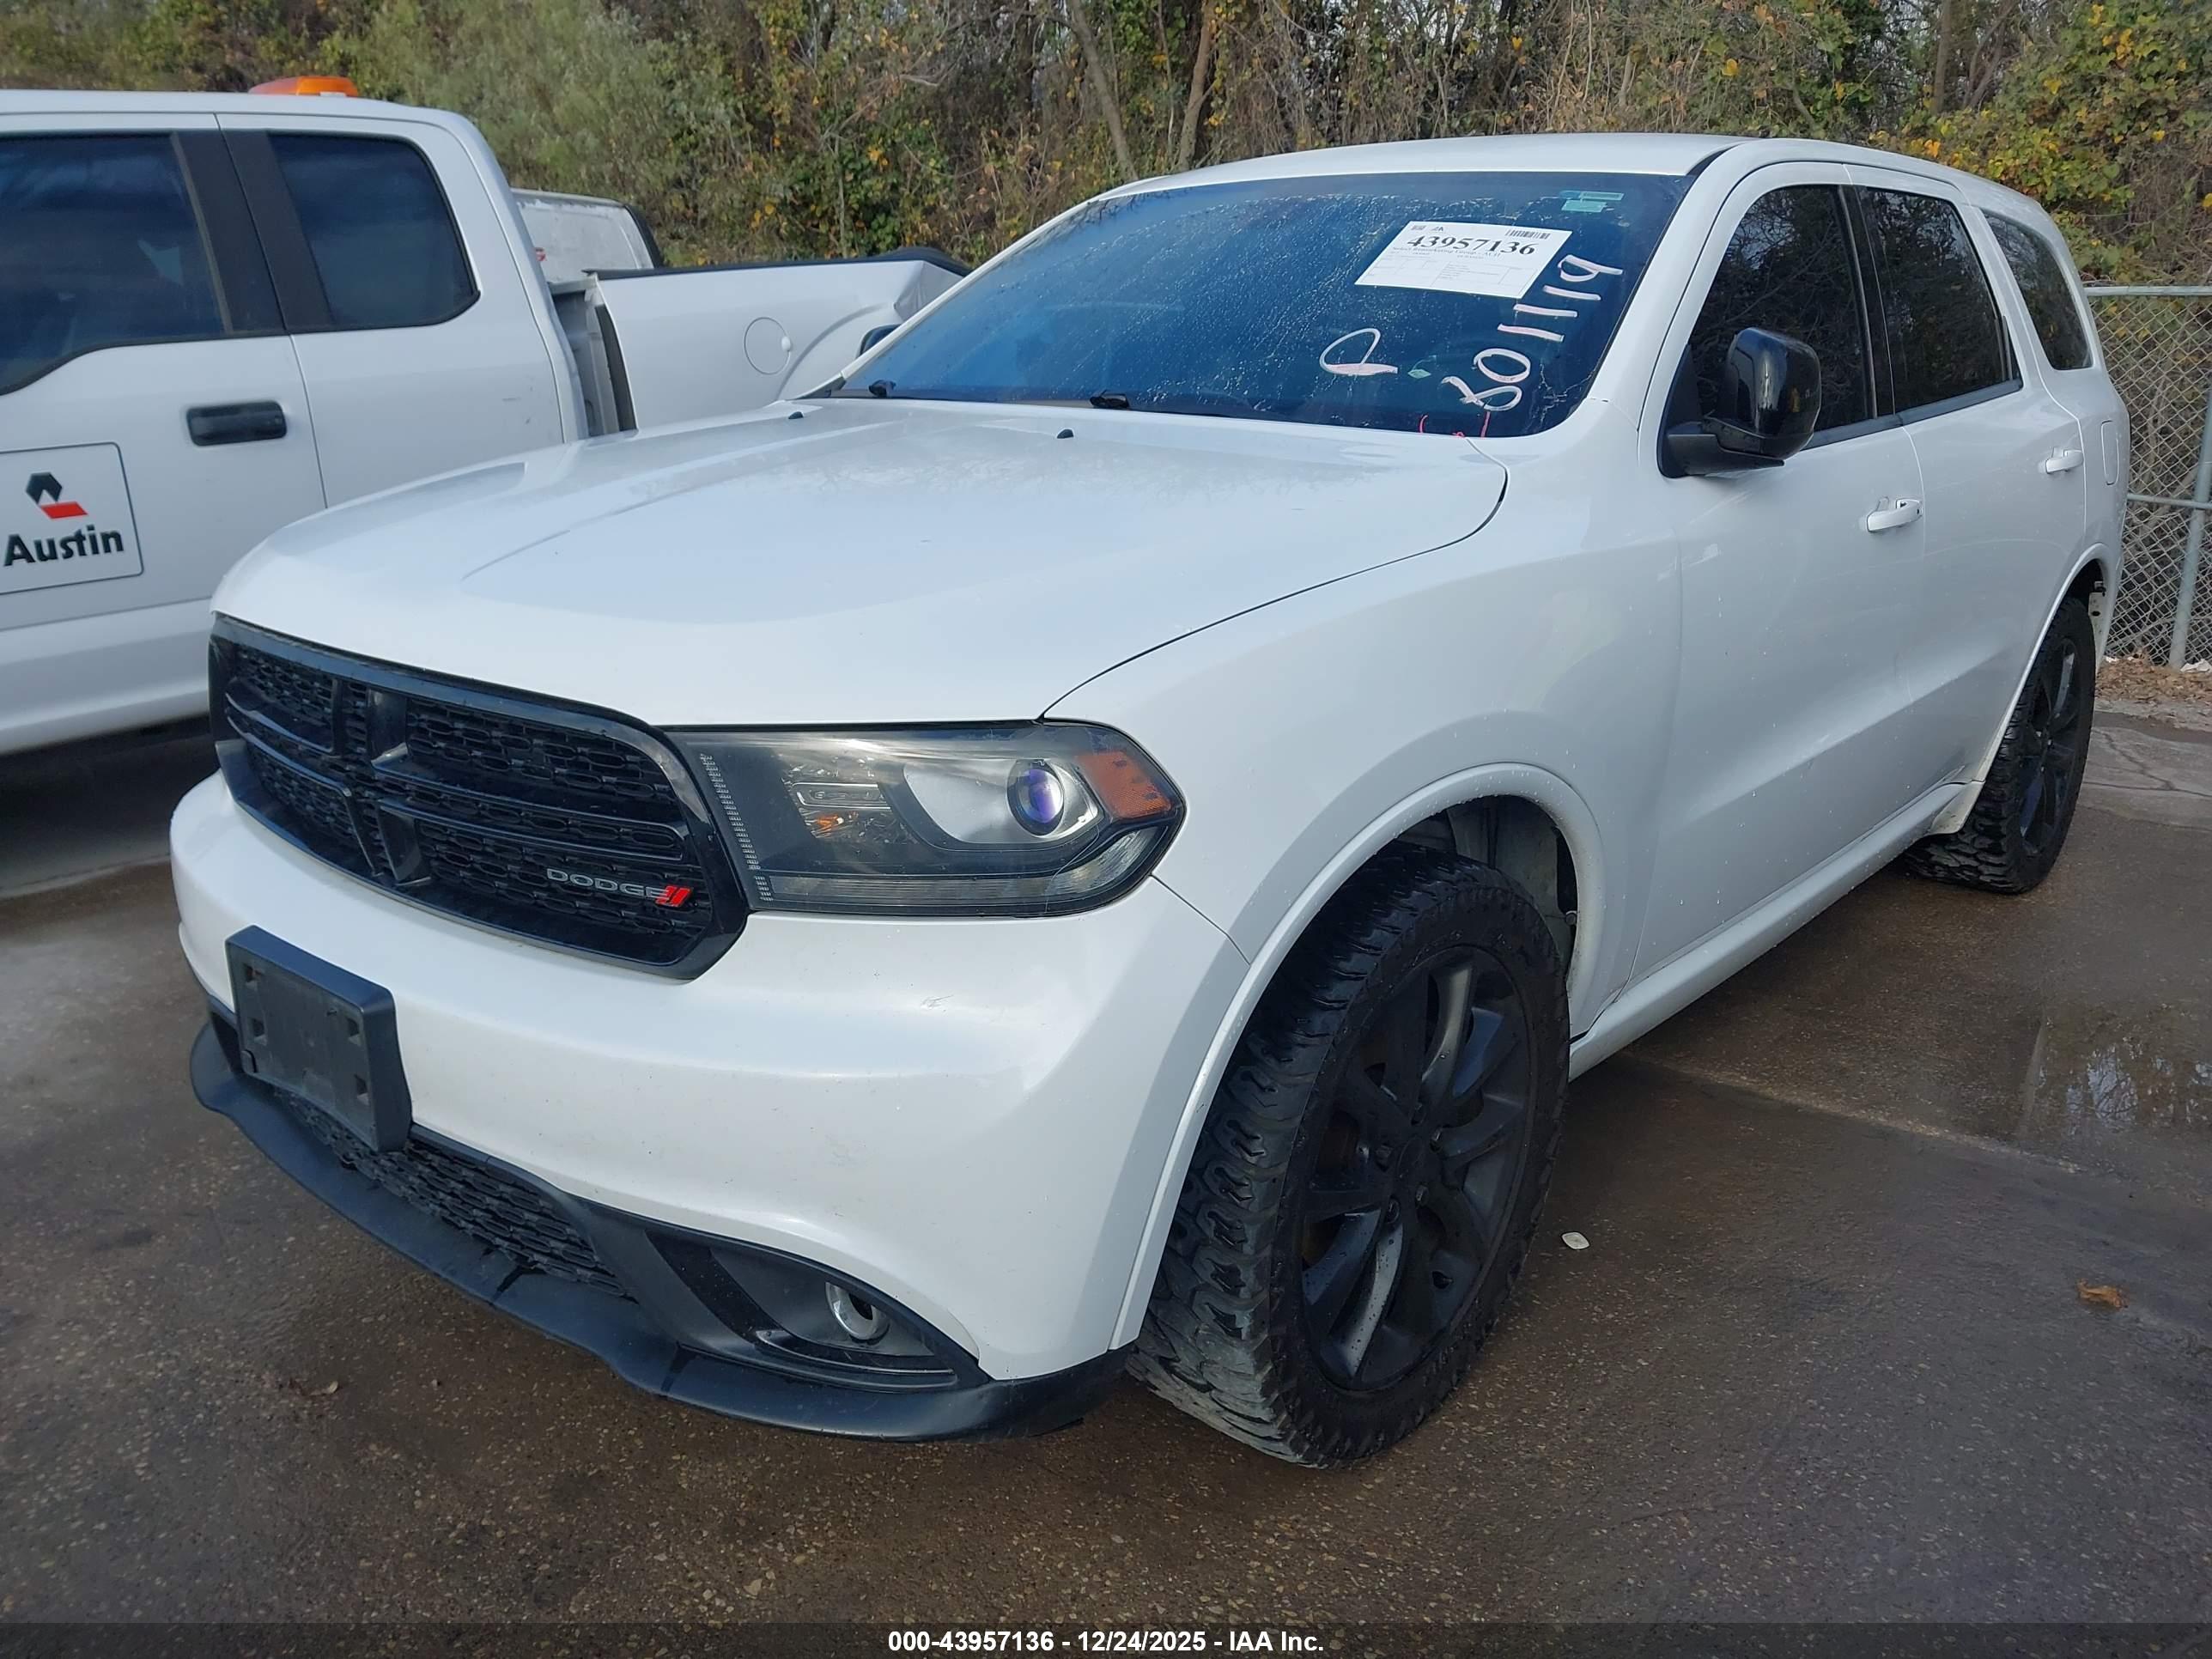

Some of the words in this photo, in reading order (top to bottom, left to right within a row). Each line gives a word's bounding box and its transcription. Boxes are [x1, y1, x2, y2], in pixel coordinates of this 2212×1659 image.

[1407, 235, 1540, 255] 43957136
[3, 524, 125, 567] Austin
[546, 867, 672, 901] DODGE
